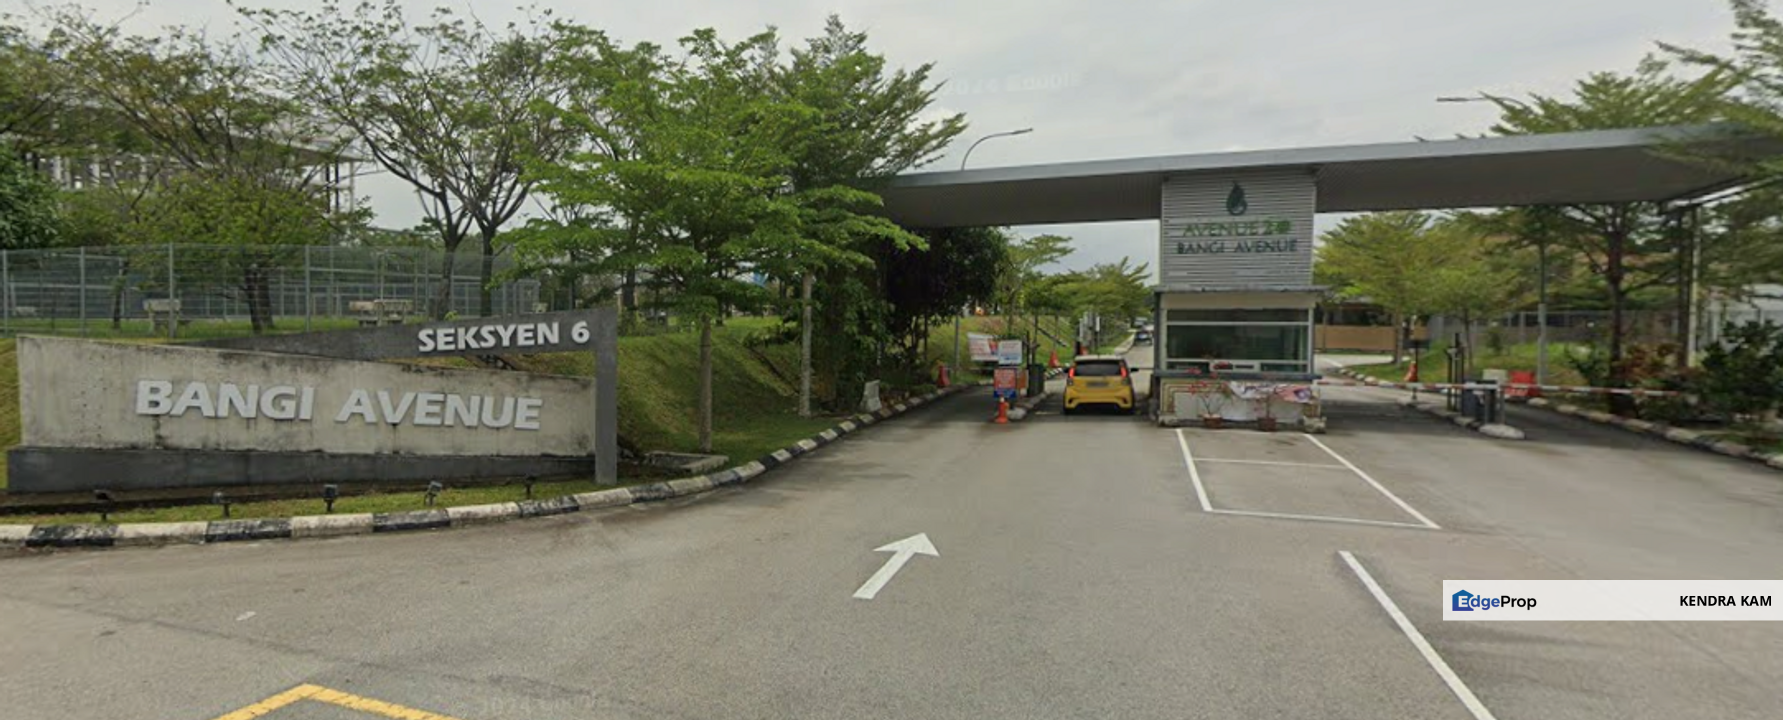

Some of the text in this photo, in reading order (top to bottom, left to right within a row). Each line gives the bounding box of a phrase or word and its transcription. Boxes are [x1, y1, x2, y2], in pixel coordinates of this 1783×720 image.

[1183, 222, 1260, 237] AVENUE
[1177, 238, 1298, 254] BANGI AVENUE
[417, 321, 591, 352] SEKSYEN 6
[136, 380, 542, 430] BANGI AVENUE
